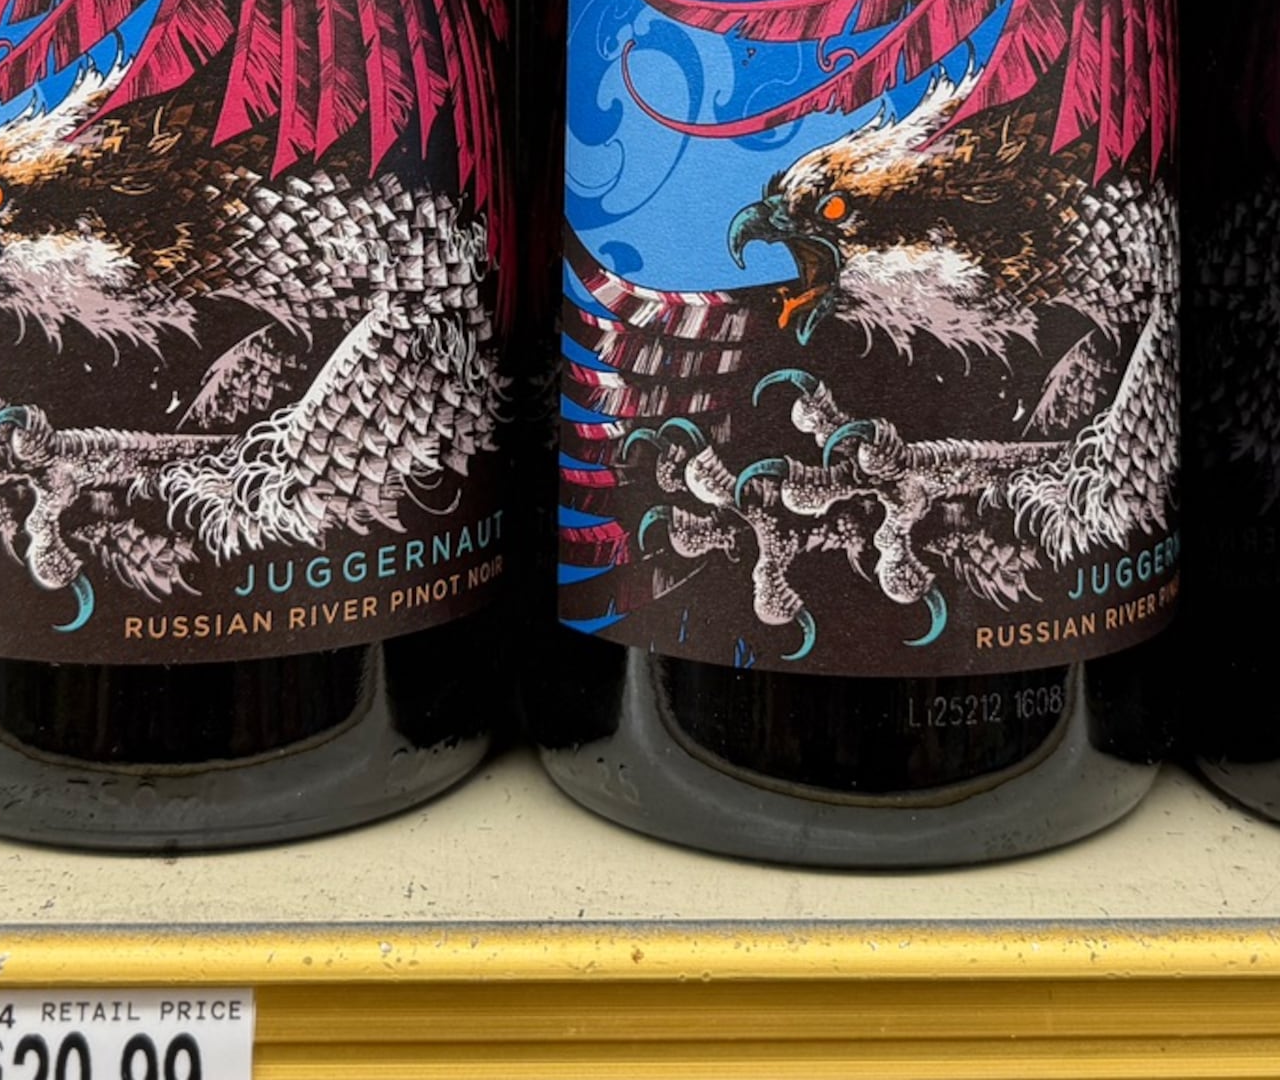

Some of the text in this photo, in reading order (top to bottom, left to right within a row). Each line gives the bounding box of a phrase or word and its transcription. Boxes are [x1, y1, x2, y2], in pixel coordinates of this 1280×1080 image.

[234, 509, 505, 598] JUGGERNAUT
[124, 554, 504, 640] RUSSIAN RIVER PINOT NOIR
[975, 611, 1096, 650] RUSSIAN
[1106, 592, 1156, 630] RIVER
[41, 1000, 242, 1022] RETAIL PRICE
